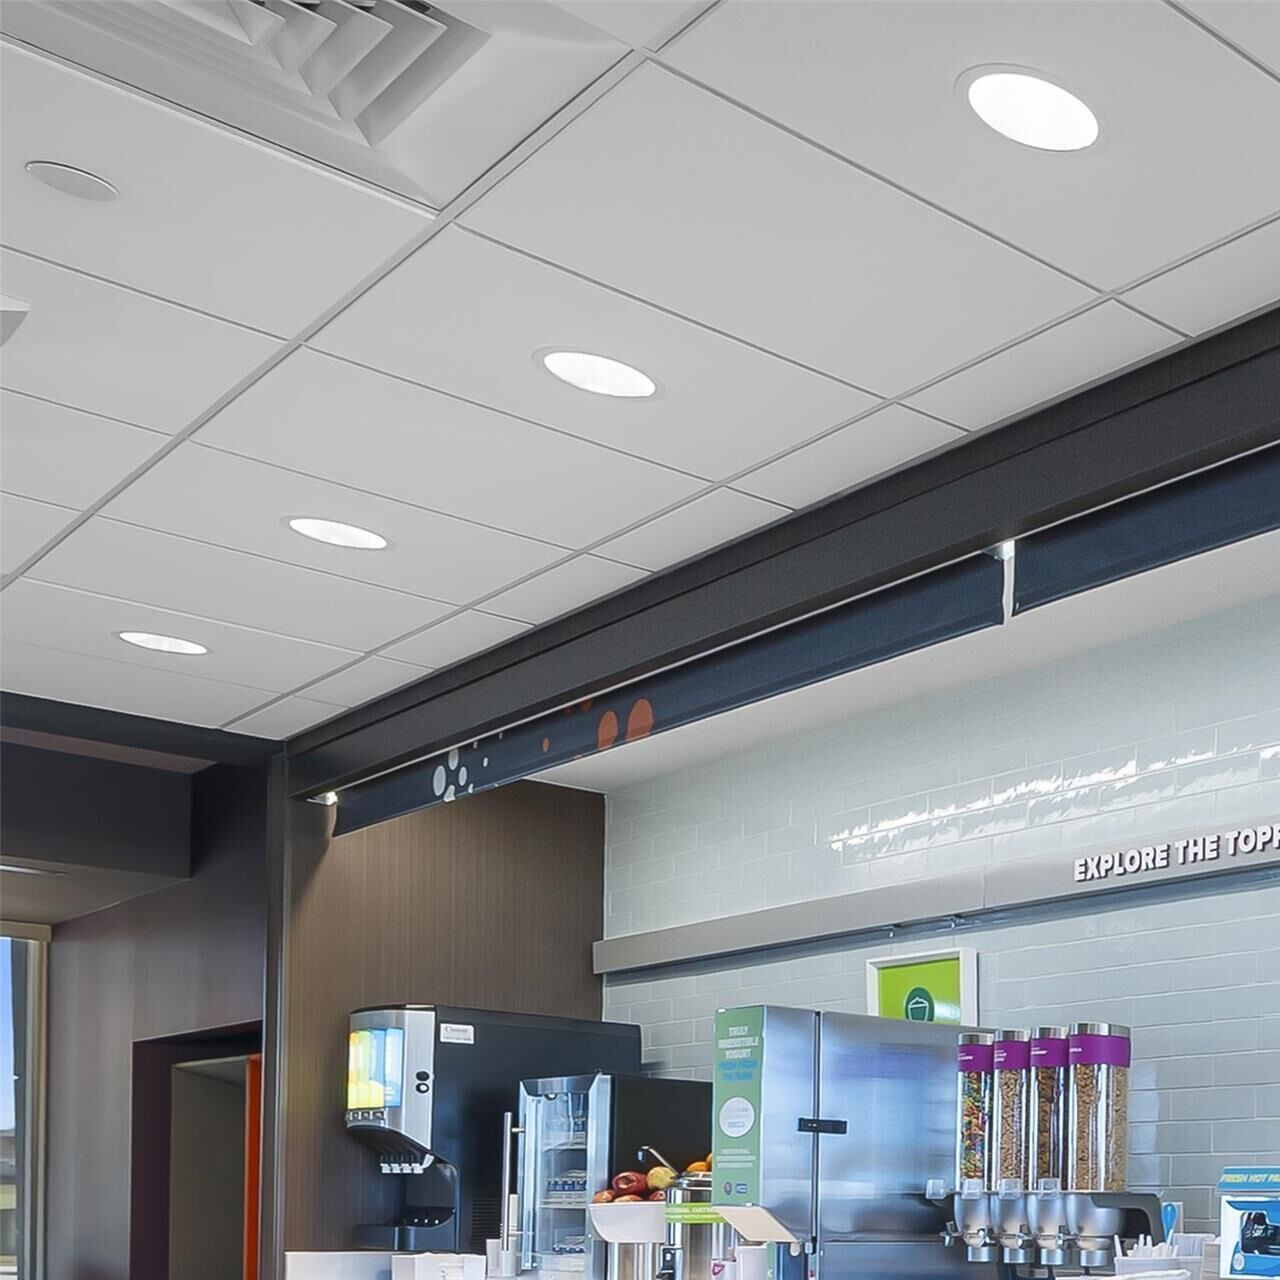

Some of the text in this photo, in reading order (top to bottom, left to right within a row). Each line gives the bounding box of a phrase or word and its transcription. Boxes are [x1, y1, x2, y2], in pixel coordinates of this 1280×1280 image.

[1073, 842, 1171, 882] EXPLORE
[1175, 834, 1220, 866] THE
[1219, 1173, 1247, 1183] FRESH
[1248, 1173, 1268, 1183] HOT
